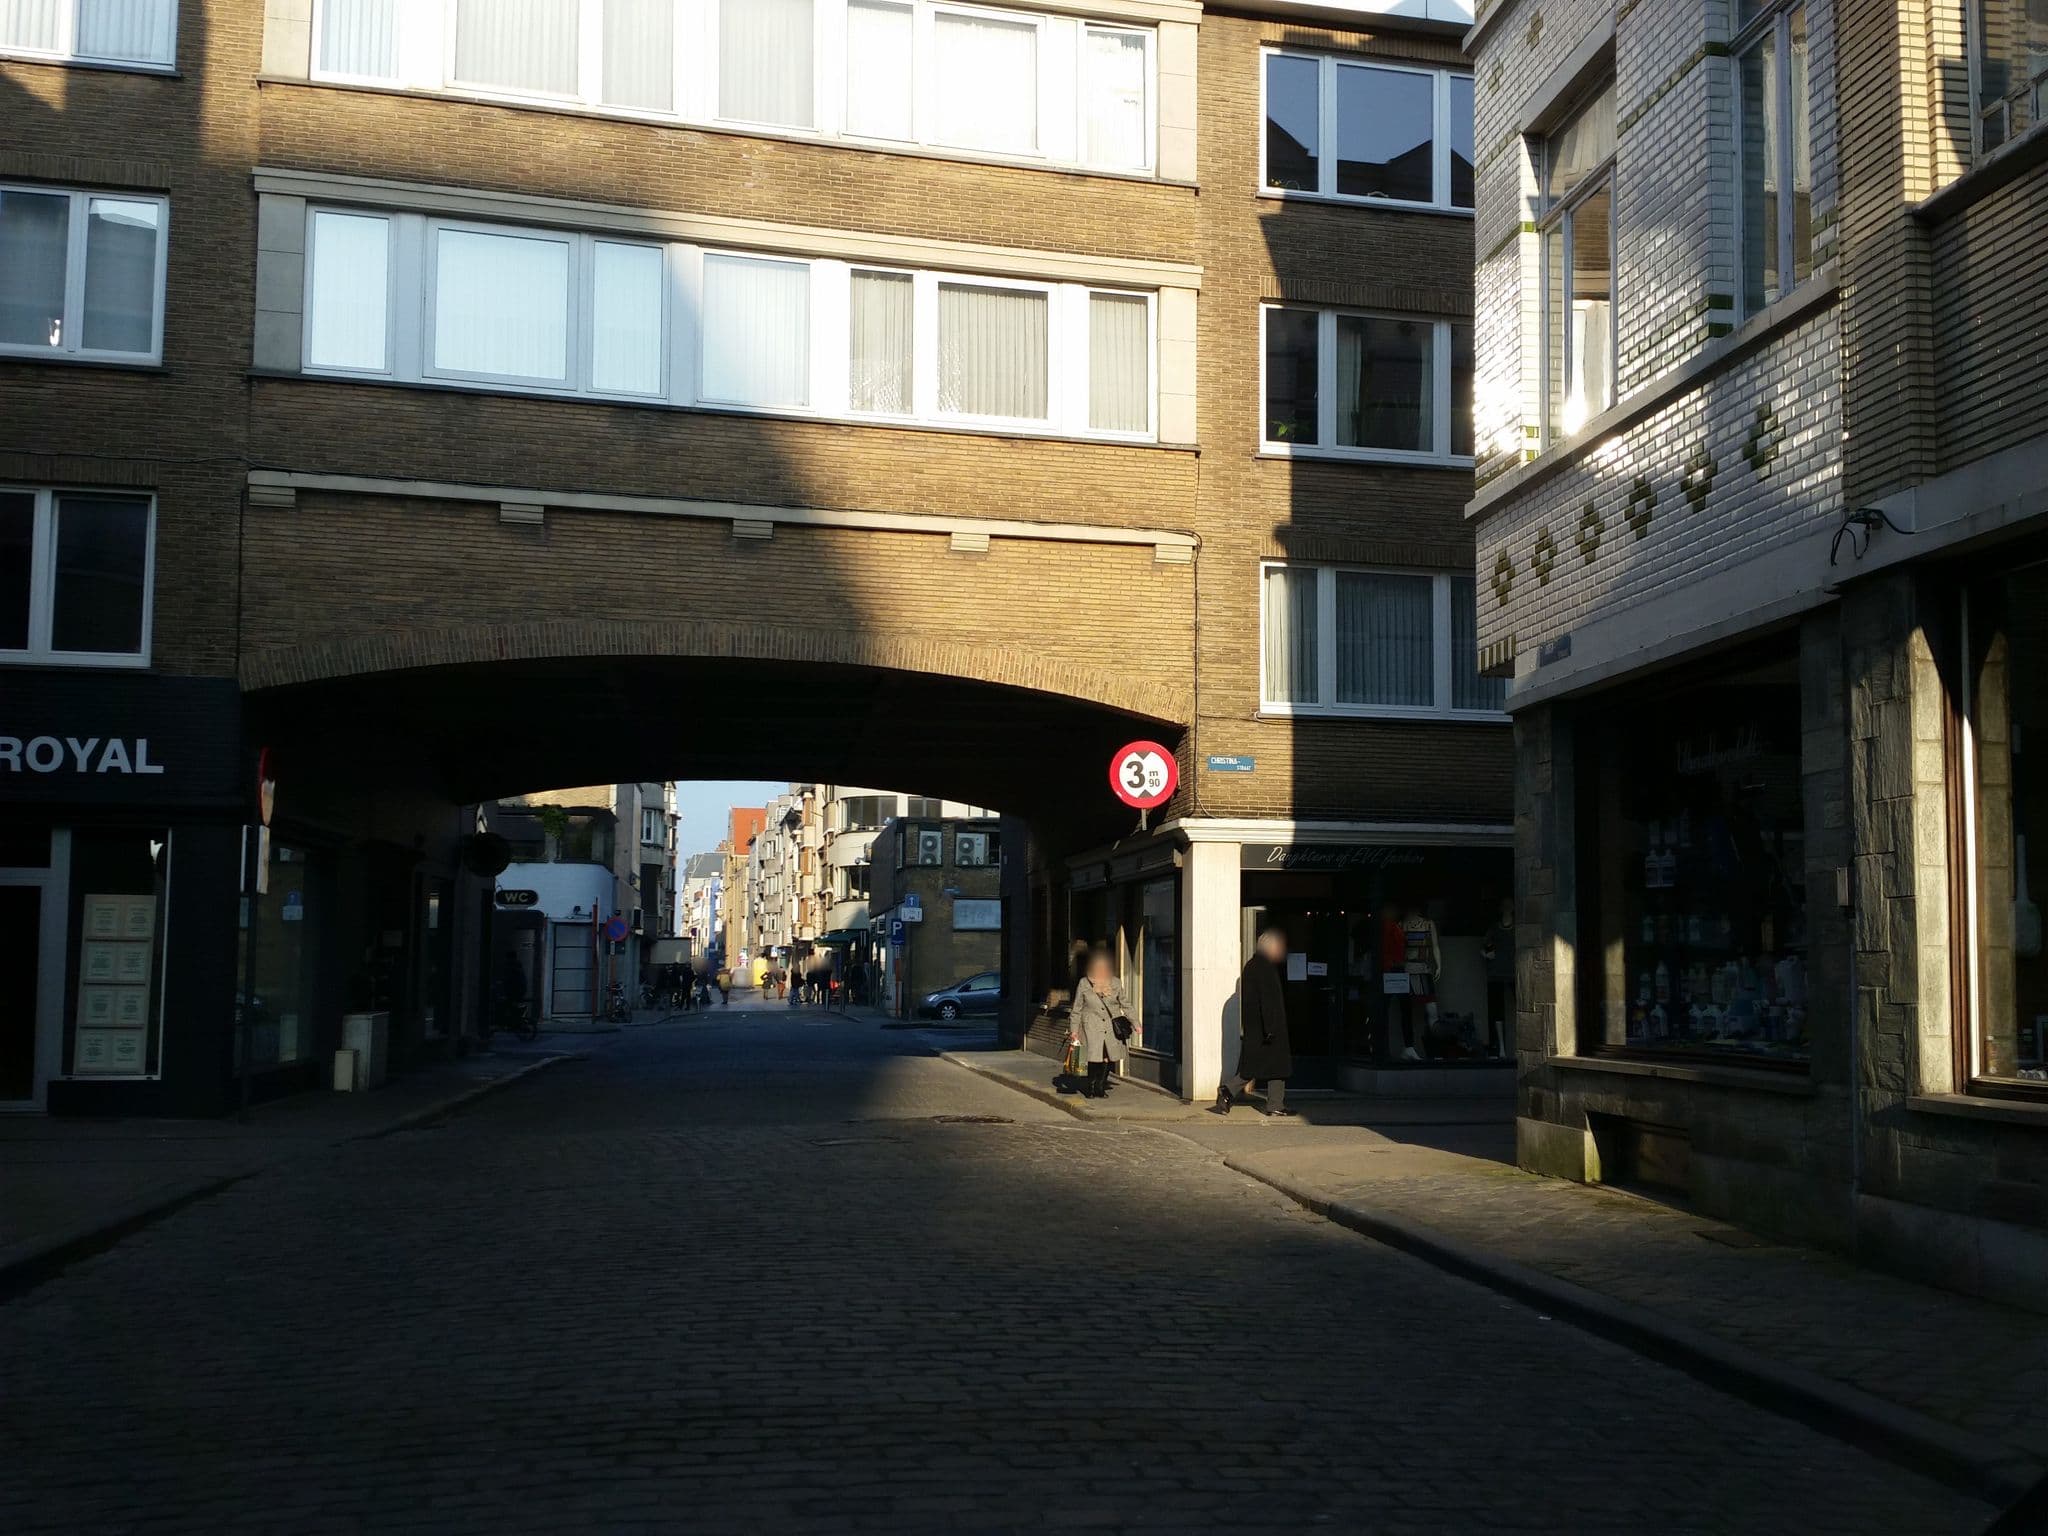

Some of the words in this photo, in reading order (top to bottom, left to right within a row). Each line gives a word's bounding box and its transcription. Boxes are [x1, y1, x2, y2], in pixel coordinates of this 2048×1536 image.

[0, 735, 165, 774] ROYAL
[1126, 760, 1146, 789] 3
[1148, 778, 1161, 788] 90
[504, 892, 529, 903] WC
[892, 921, 903, 936] P
